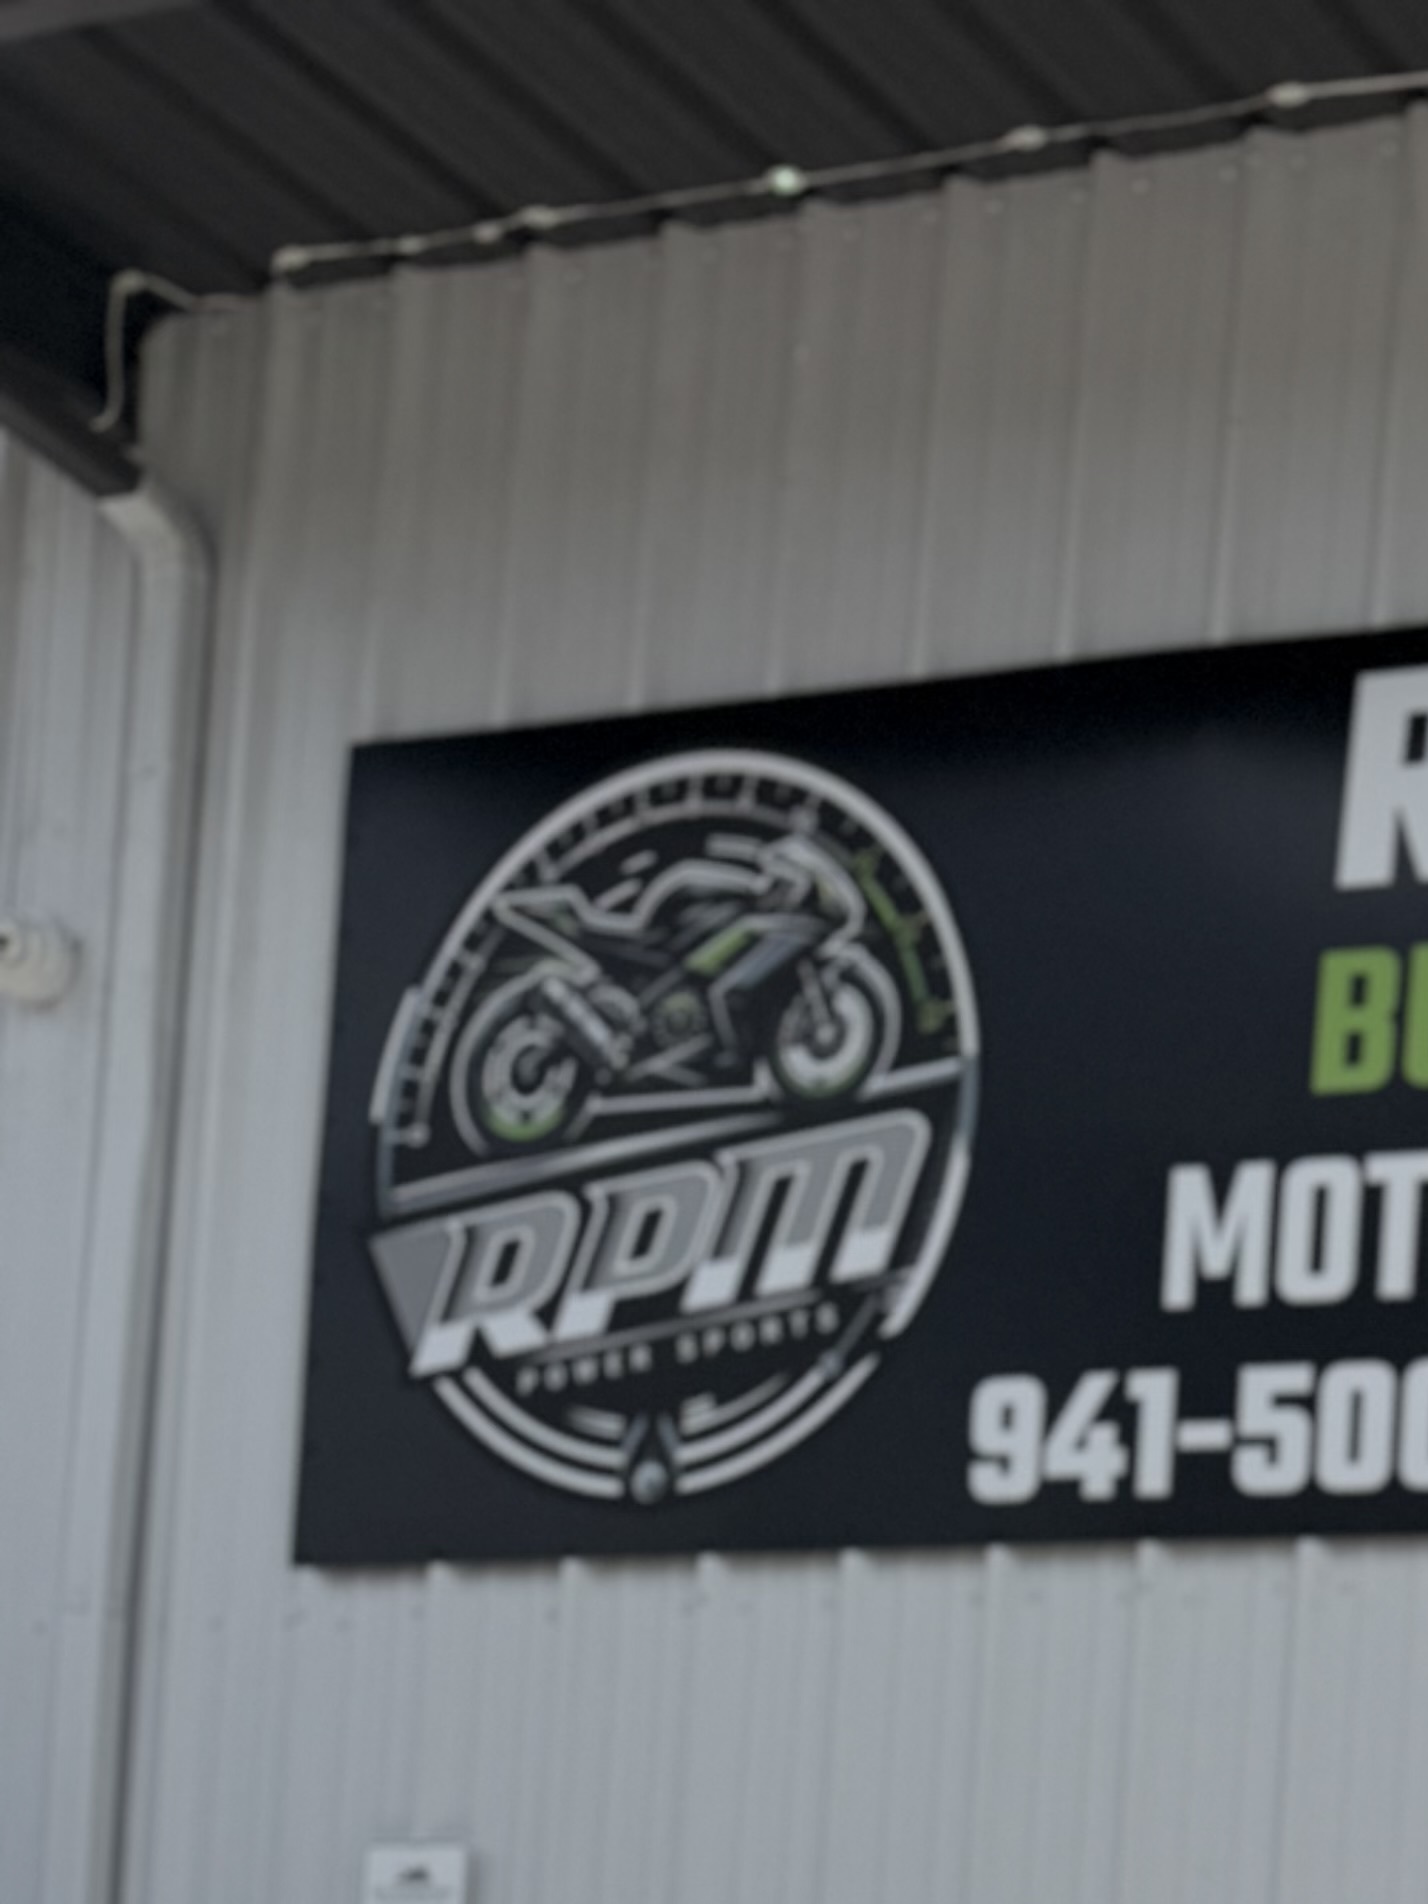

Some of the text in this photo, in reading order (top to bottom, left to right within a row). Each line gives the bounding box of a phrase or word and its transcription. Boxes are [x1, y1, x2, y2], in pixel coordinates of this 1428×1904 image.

[407, 1107, 935, 1379] RPM
[515, 1303, 843, 1397] POWER SPORTS
